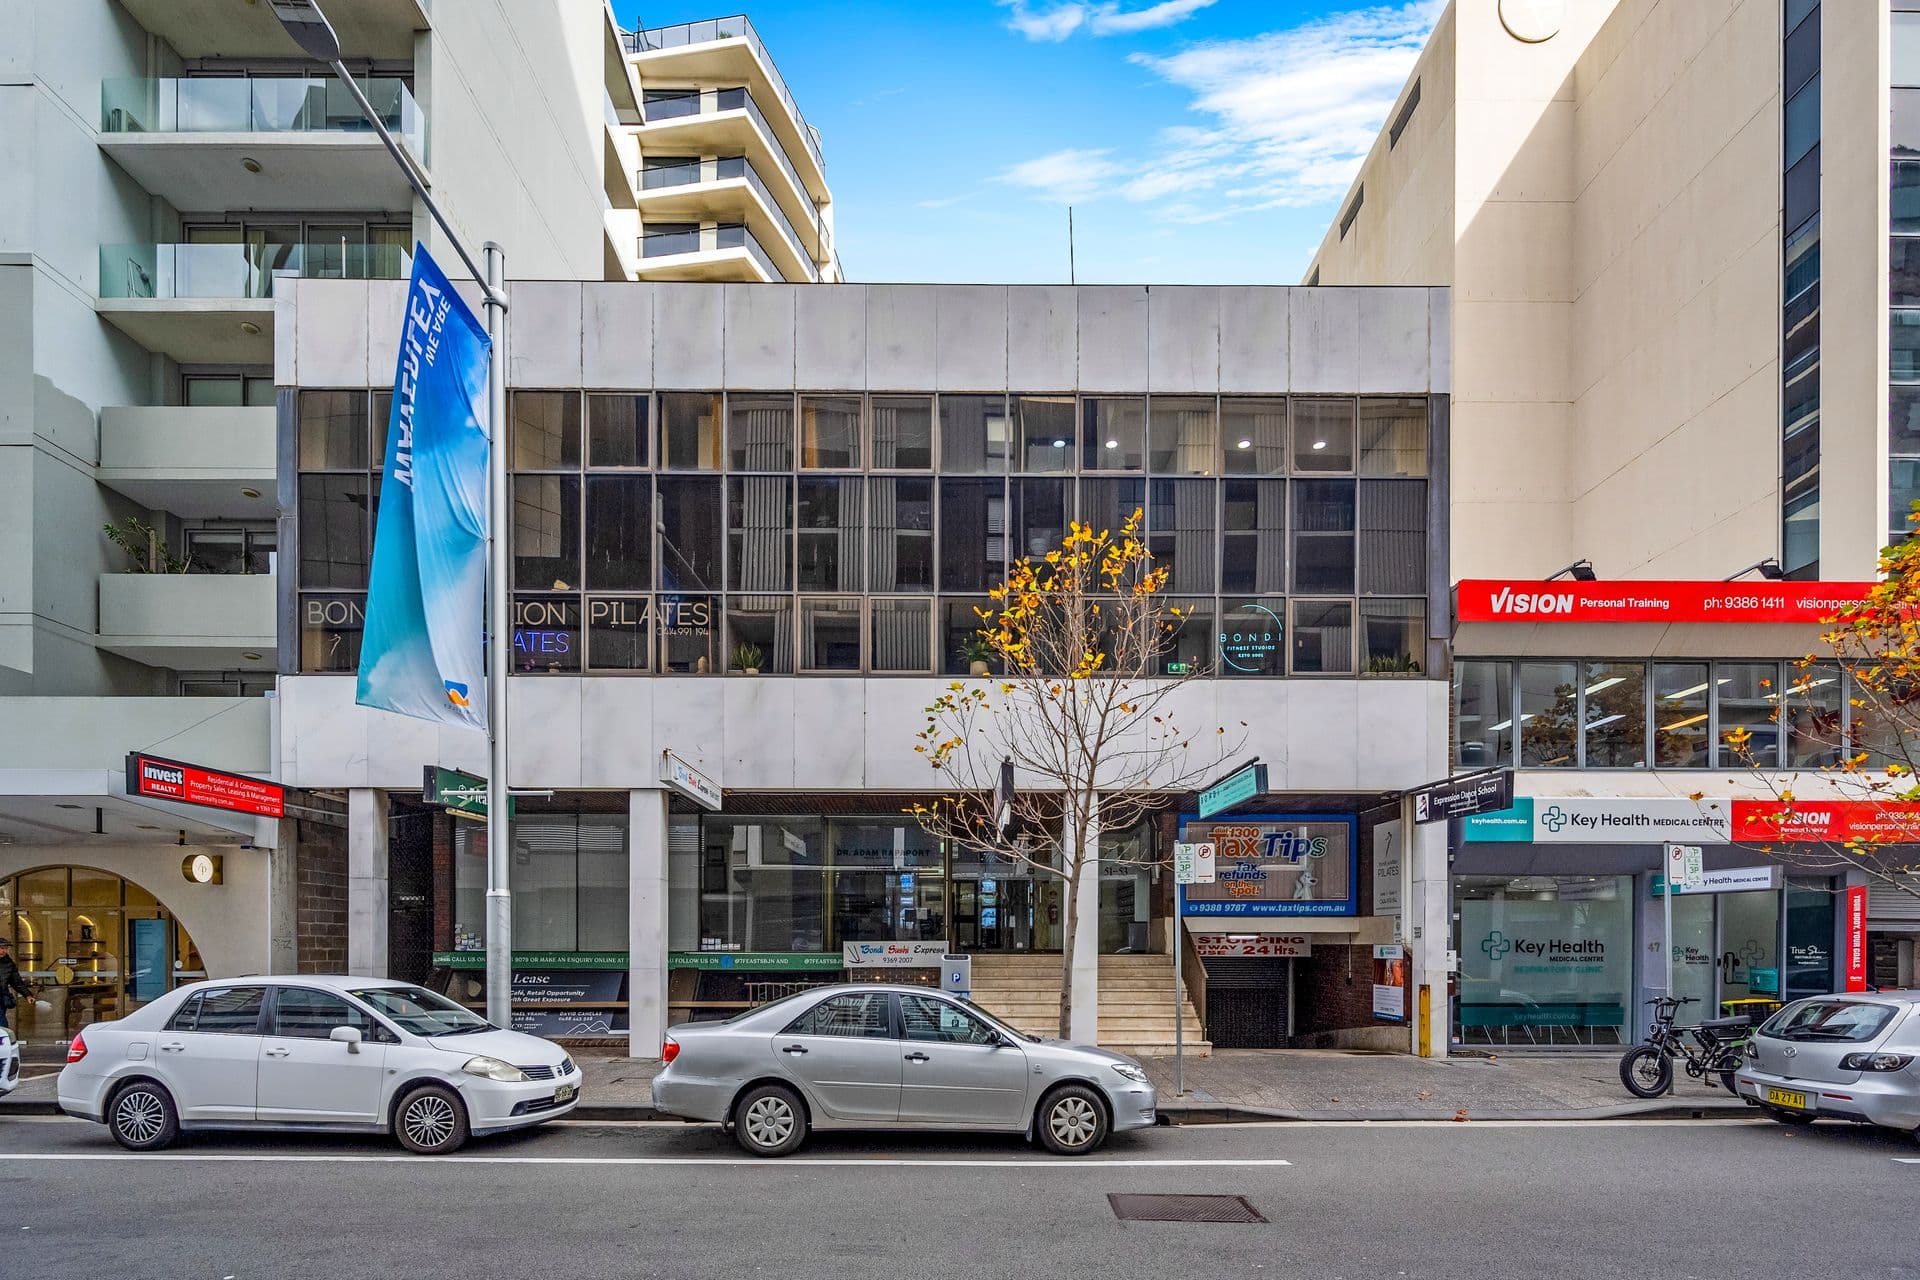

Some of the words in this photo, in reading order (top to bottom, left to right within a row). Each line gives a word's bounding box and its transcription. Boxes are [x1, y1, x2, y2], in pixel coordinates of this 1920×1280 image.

[1490, 586, 1574, 614] VISION
[1580, 597, 1626, 608] Personal
[1629, 597, 1670, 609] Training
[1703, 597, 1723, 610] ph:
[1724, 596, 1759, 608] 9386
[1760, 596, 1785, 608] 1411
[591, 601, 709, 626] PILATES
[678, 627, 692, 637] 991
[695, 627, 709, 637] 194
[1220, 632, 1282, 643] BONDI
[144, 763, 183, 785] invest
[151, 783, 177, 793] REALTY
[207, 775, 235, 788] Residential
[239, 783, 267, 794] Commercial
[190, 780, 212, 792] Property
[227, 787, 246, 799] Leasing
[250, 791, 280, 805] Management
[1433, 793, 1461, 807] Expression
[1477, 783, 1497, 796] School
[1471, 817, 1528, 826] keyhealth.com.au
[1571, 813, 1598, 829] Key
[1601, 812, 1650, 826] Health
[1653, 818, 1691, 826] MEDICAL
[1692, 818, 1724, 827] CENTRE
[1229, 827, 1260, 838] 1300
[853, 849, 879, 857] ADAM
[1208, 832, 1260, 858] Tax
[1263, 831, 1328, 864] Tips
[1103, 866, 1129, 876] 51-53
[1179, 863, 1191, 872] 3P
[1235, 861, 1257, 872] Tax
[1219, 870, 1268, 880] refunds
[1708, 877, 1732, 885] Health
[1230, 886, 1260, 896] spot!
[1199, 903, 1222, 912] 9388
[1252, 903, 1346, 914] www.taxtips.com.au
[1853, 895, 1861, 912] YOUR
[1853, 912, 1861, 930] BODY.
[1853, 930, 1861, 948] YOUR
[860, 944, 884, 955] Bondi
[913, 944, 945, 956] Express
[1242, 945, 1270, 955] 24
[1274, 945, 1299, 955] Hrs.
[1515, 939, 1545, 957] Key
[1549, 938, 1604, 954] Health
[1648, 942, 1661, 952] 47
[1685, 946, 1699, 955] Key
[1790, 946, 1806, 954] True
[513, 973, 551, 984] Lease
[953, 973, 960, 983] P
[1781, 1092, 1791, 1104] 27
